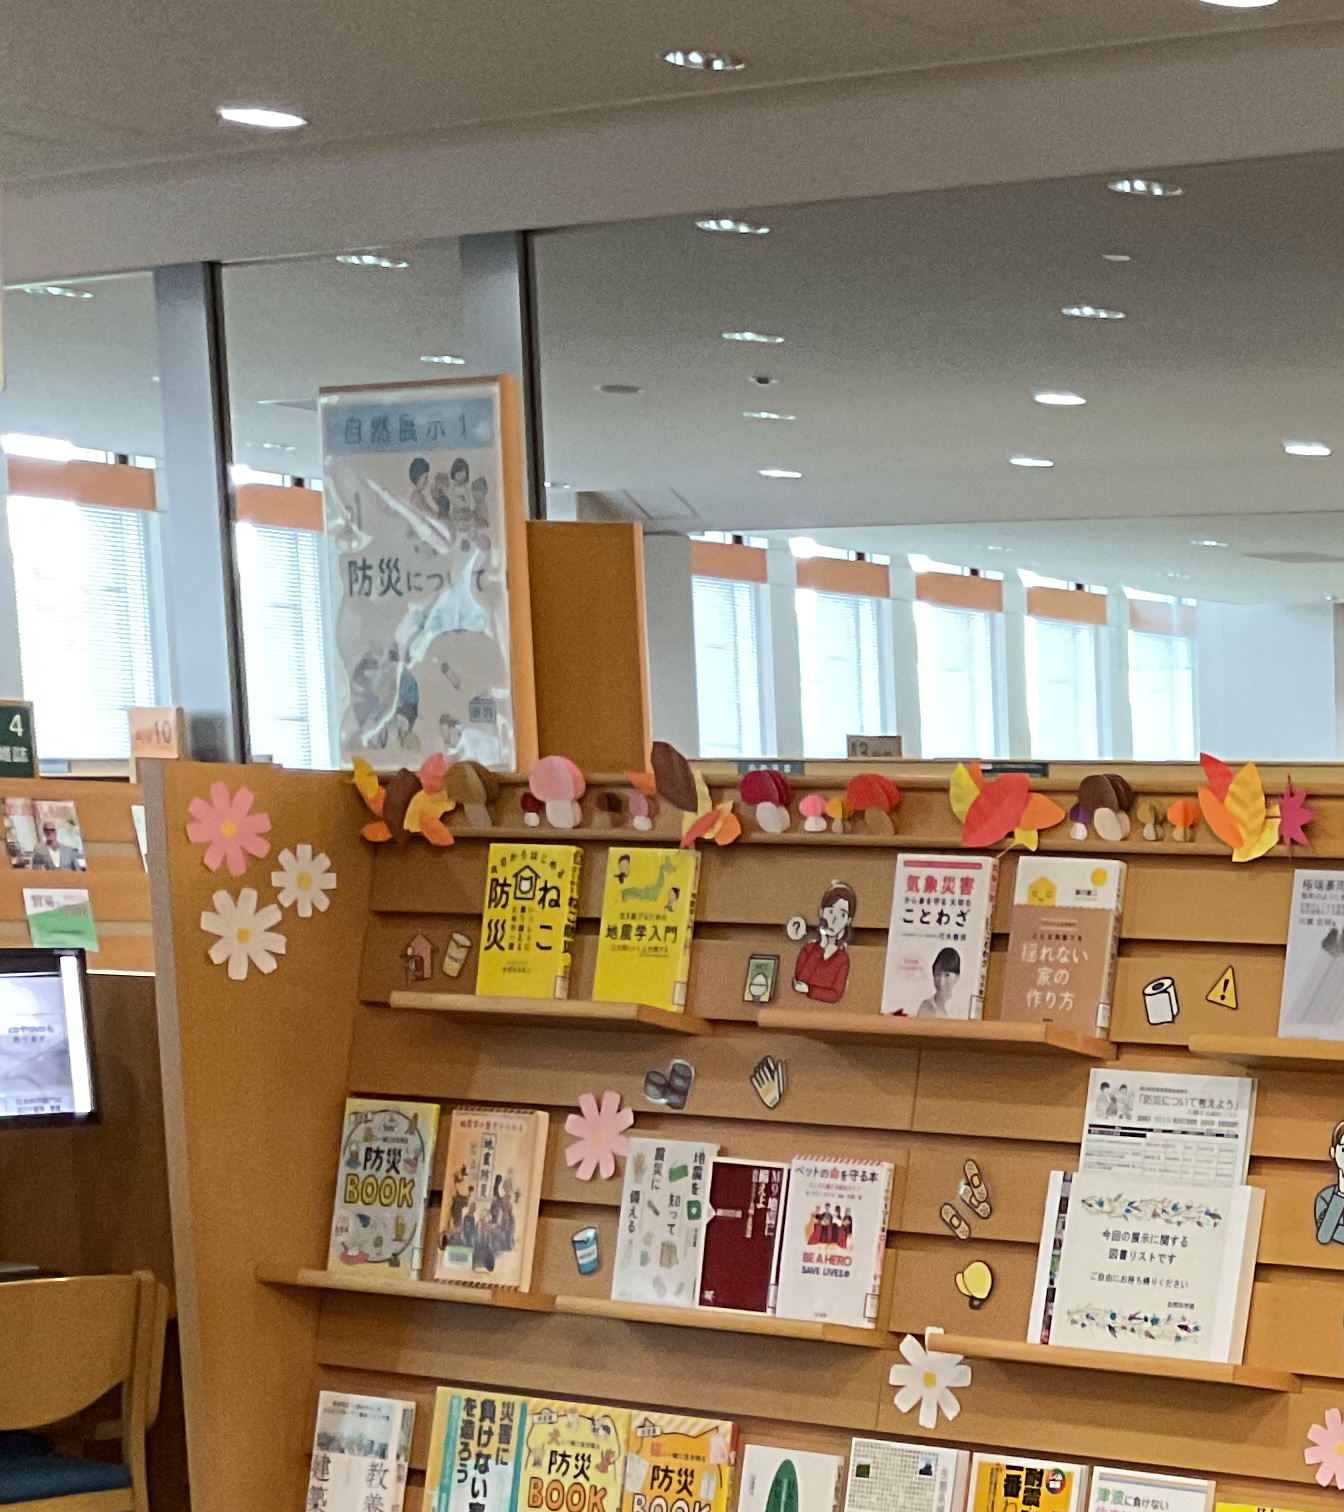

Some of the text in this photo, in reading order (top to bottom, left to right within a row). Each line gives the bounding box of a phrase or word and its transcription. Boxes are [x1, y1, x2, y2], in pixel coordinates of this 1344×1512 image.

[9, 714, 24, 737] 4
[905, 874, 976, 897] 気象災害
[901, 907, 971, 928] ことわざ
[605, 923, 679, 944] 地震学入門
[1035, 966, 1070, 987] 家の
[1025, 990, 1076, 1012] 作り方
[362, 1146, 403, 1175] 防災
[691, 1151, 706, 1197] 地震を
[795, 1165, 879, 1185] ペットの命を守る本
[343, 1173, 416, 1209] BOOK
[627, 1190, 641, 1234] 備える
[666, 1193, 682, 1236] 知って
[1101, 1228, 1190, 1249] 今回の展示に関する
[802, 1251, 816, 1264] BE
[824, 1253, 853, 1267] HERO
[1107, 1247, 1178, 1266] 図書リストです
[1089, 1271, 1190, 1291] ご自由にお持ち帰りください
[494, 1401, 516, 1467] 災害に
[547, 1449, 592, 1482] 防災
[649, 1464, 696, 1498] 防災
[1096, 1486, 1170, 1512] 津波に負けない
